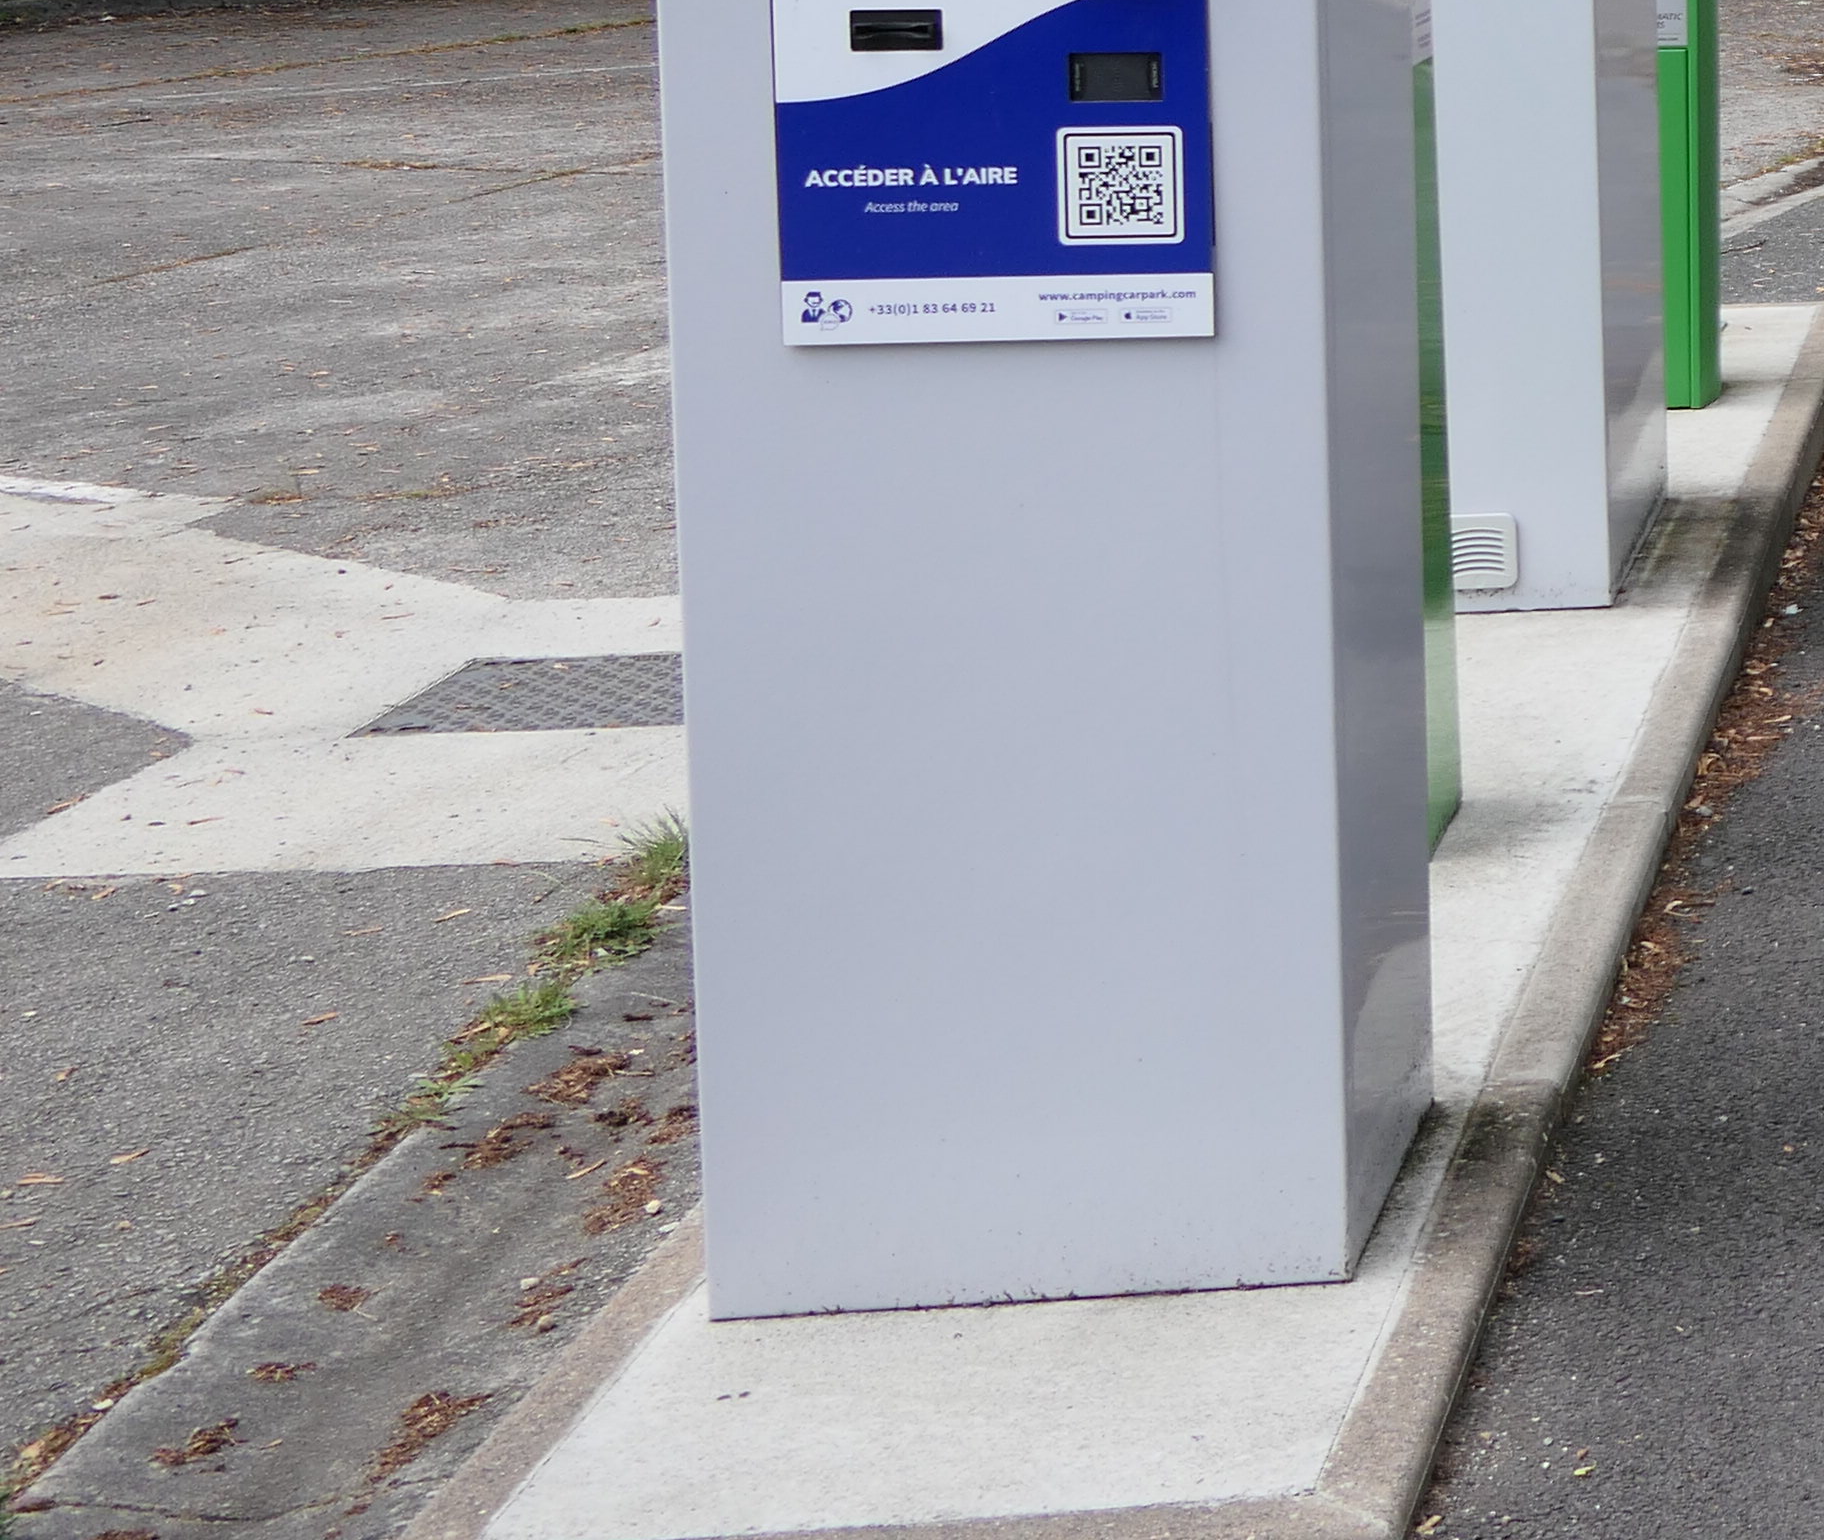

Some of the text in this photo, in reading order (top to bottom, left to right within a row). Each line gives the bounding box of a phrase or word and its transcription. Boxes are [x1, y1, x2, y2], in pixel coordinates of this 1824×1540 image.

[805, 164, 1018, 188] ACCÉDER À L'AIRE
[864, 200, 960, 213] Access the area
[1038, 289, 1197, 303] www.campingcarpark.com
[868, 302, 996, 317] +33(0)1 83 64 69 21
